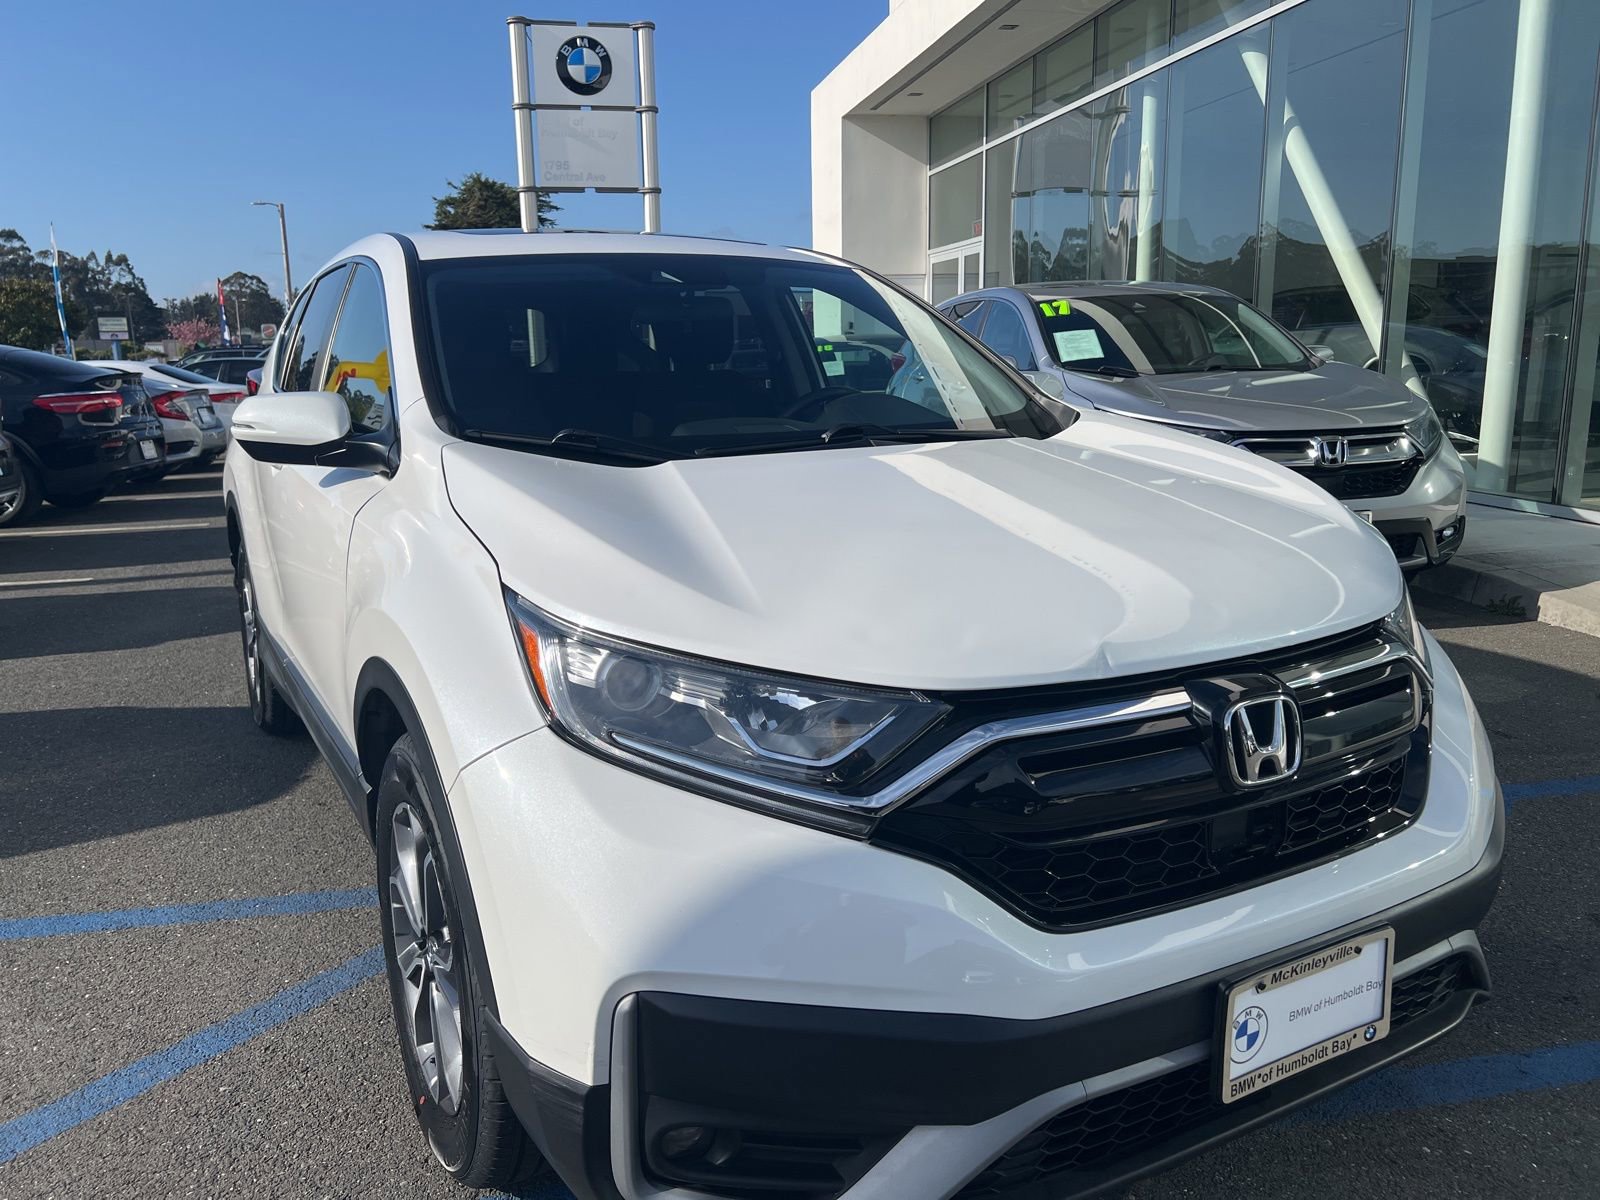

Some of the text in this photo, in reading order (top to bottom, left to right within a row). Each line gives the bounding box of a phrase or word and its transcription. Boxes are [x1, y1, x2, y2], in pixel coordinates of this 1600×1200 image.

[561, 37, 607, 57] BMW
[572, 116, 584, 127] of
[544, 160, 570, 170] 1795
[543, 170, 606, 182] Central Ave
[1039, 299, 1071, 317] 17
[1270, 945, 1354, 985] McKinleyville
[1288, 979, 1384, 1022] BMW of Humboldt Bay
[1230, 1036, 1352, 1098] BMW of Humboldt Bay
